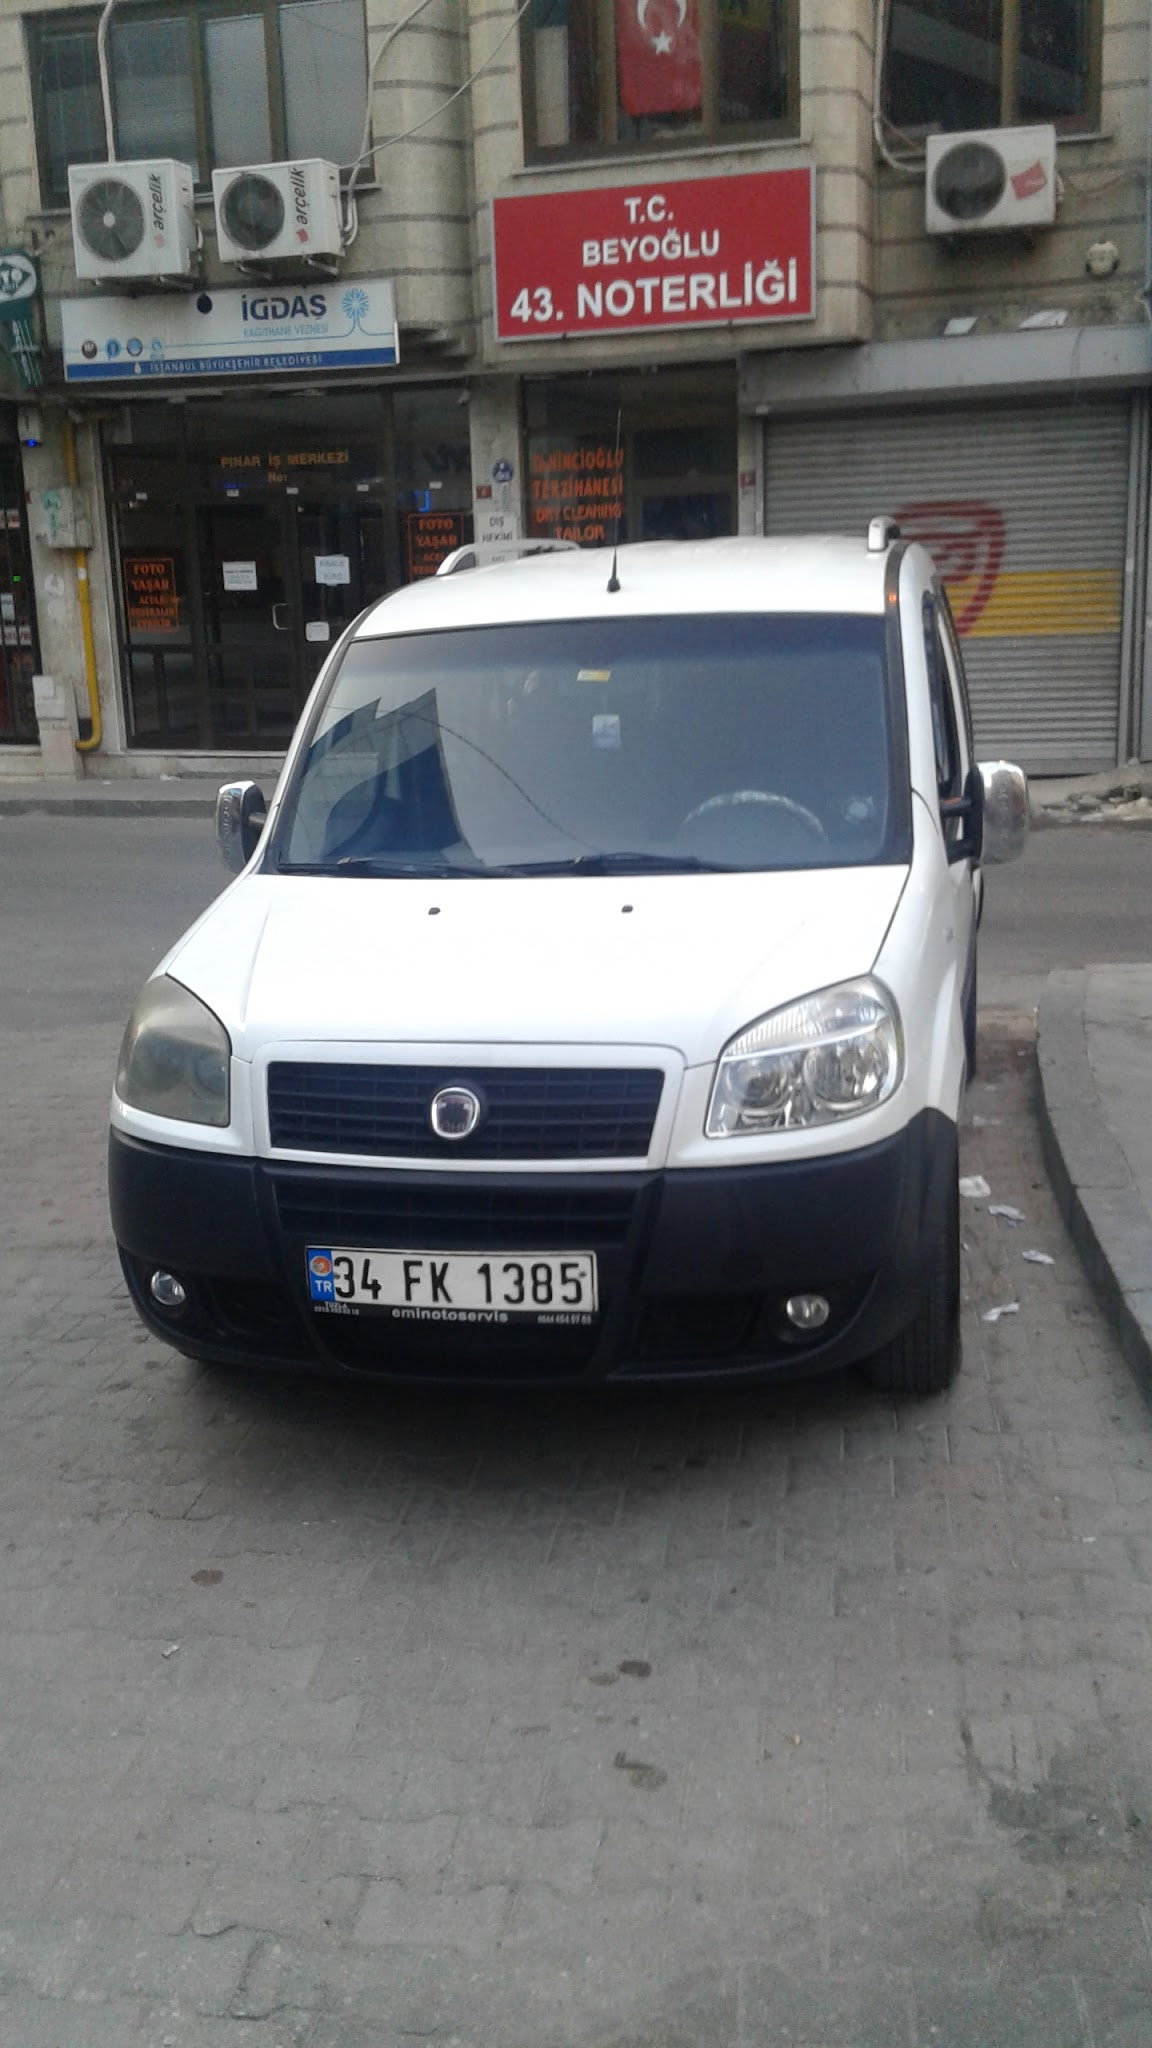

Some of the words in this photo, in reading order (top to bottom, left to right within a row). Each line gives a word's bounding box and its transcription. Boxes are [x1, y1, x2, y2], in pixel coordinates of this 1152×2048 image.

[149, 173, 165, 230] arçelik
[289, 166, 309, 226] arçelik
[624, 195, 674, 224] T.C.
[582, 227, 720, 267] BEYOĞLU
[510, 287, 564, 323] 43.
[577, 257, 798, 319] NOTERLİĞİ
[241, 294, 327, 321] İGDAŞ
[220, 455, 261, 468] PINAR
[287, 449, 349, 466] MERKEZİ
[417, 518, 454, 530] FOTO
[132, 563, 165, 575] FOTO
[315, 1280, 332, 1293] TR
[333, 1256, 382, 1300] 34
[403, 1260, 453, 1304] FK
[477, 1262, 583, 1305] 1385
[391, 1307, 509, 1323] eminotoservis
